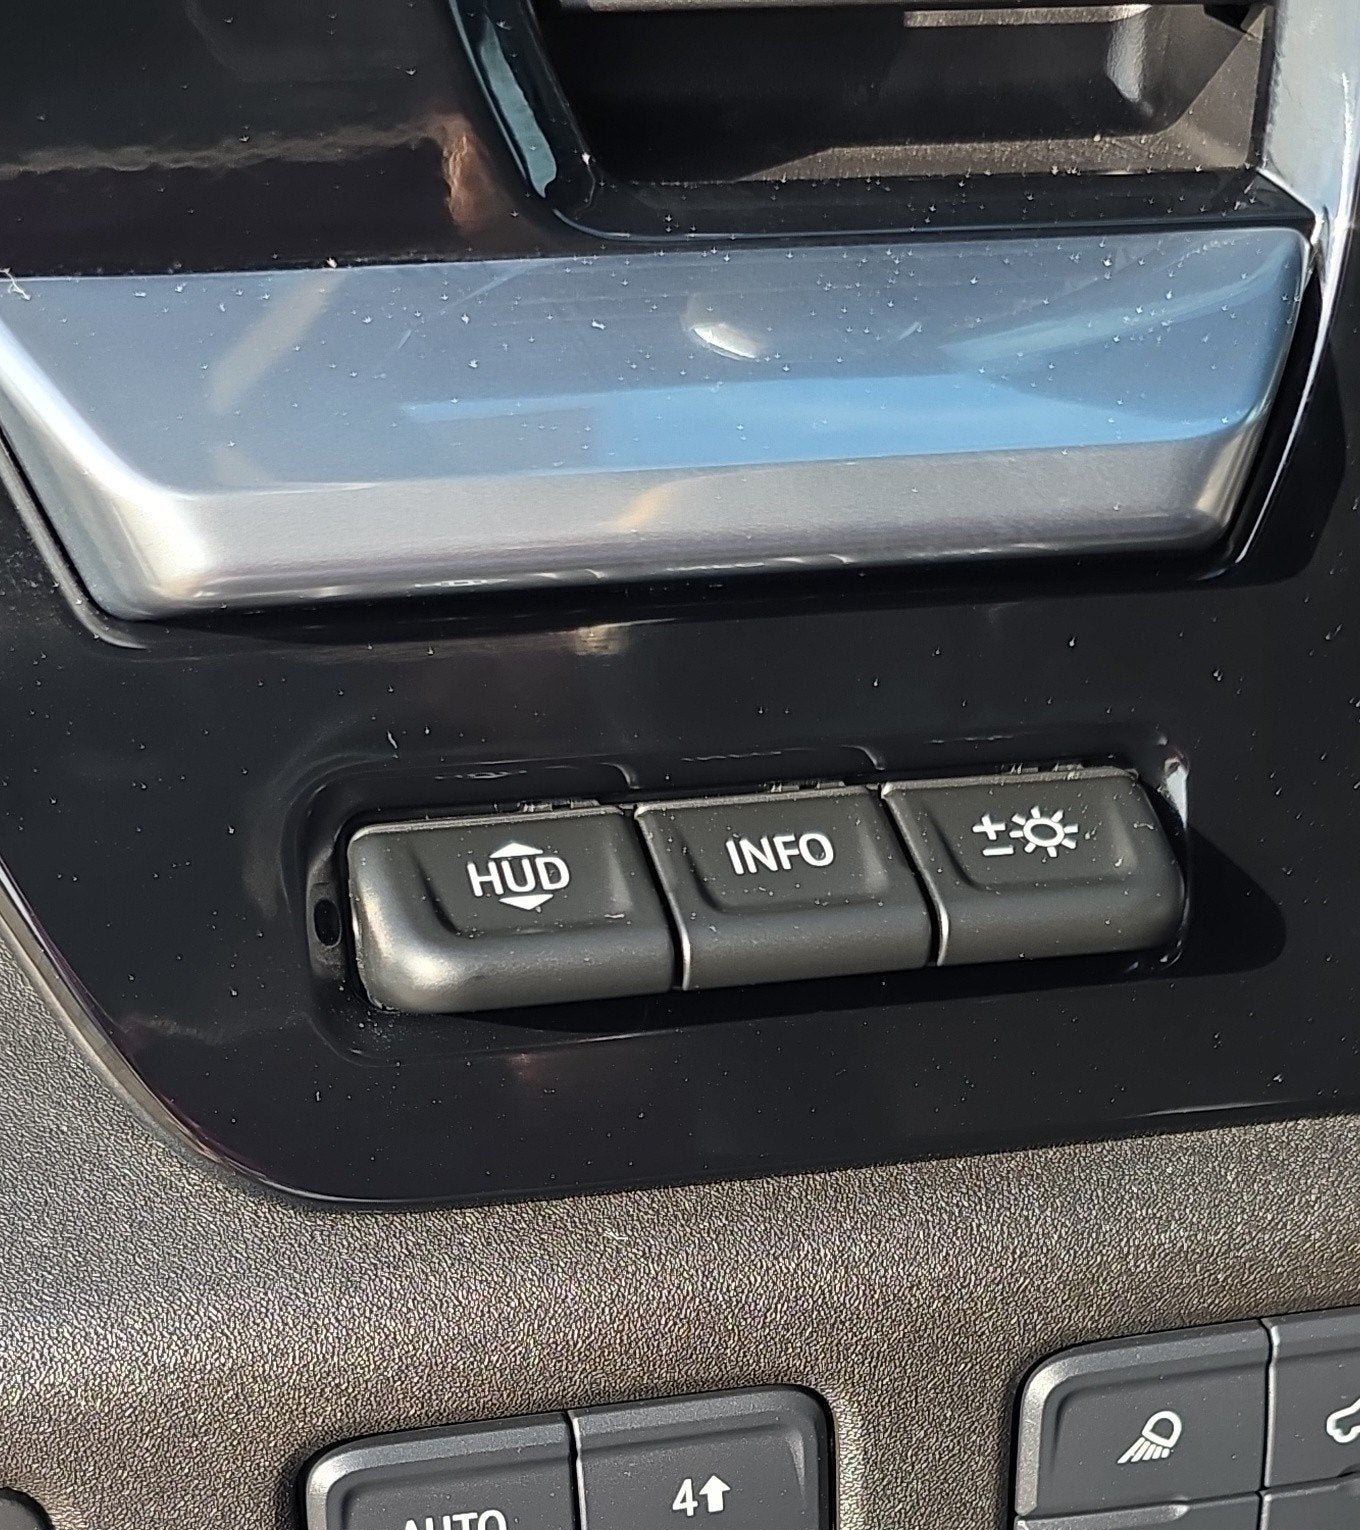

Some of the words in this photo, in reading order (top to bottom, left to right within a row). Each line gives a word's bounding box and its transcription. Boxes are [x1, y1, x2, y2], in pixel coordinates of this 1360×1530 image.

[466, 853, 571, 898] HUD
[723, 831, 837, 877] INFO
[671, 1477, 699, 1517] 4
